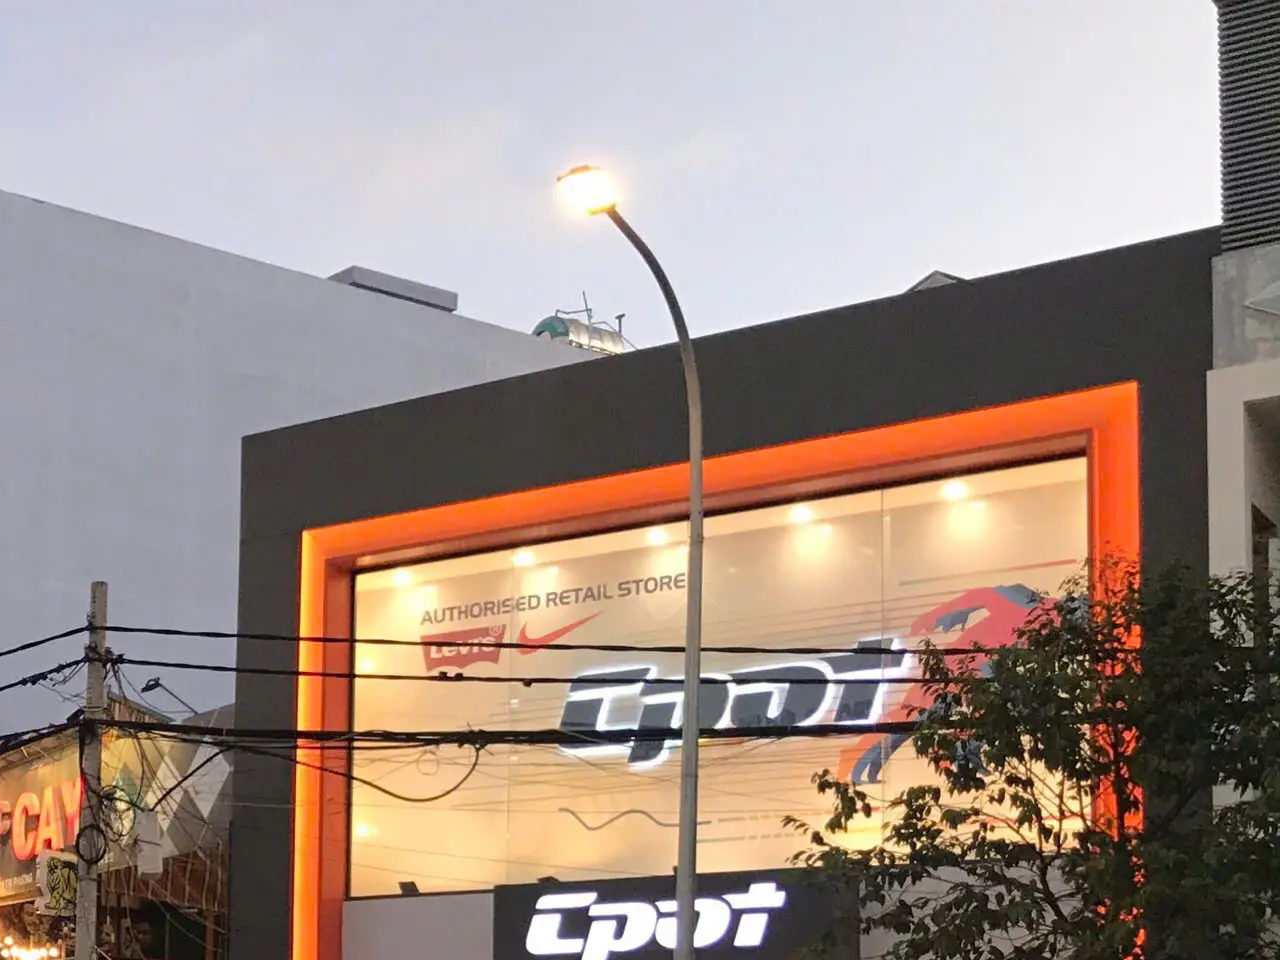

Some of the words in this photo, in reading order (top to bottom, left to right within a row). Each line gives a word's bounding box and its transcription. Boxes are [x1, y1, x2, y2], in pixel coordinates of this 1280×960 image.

[420, 595, 541, 626] AUTHORISED
[546, 582, 613, 608] RETAIL
[618, 573, 686, 598] STORE
[11, 776, 84, 861] CAY
